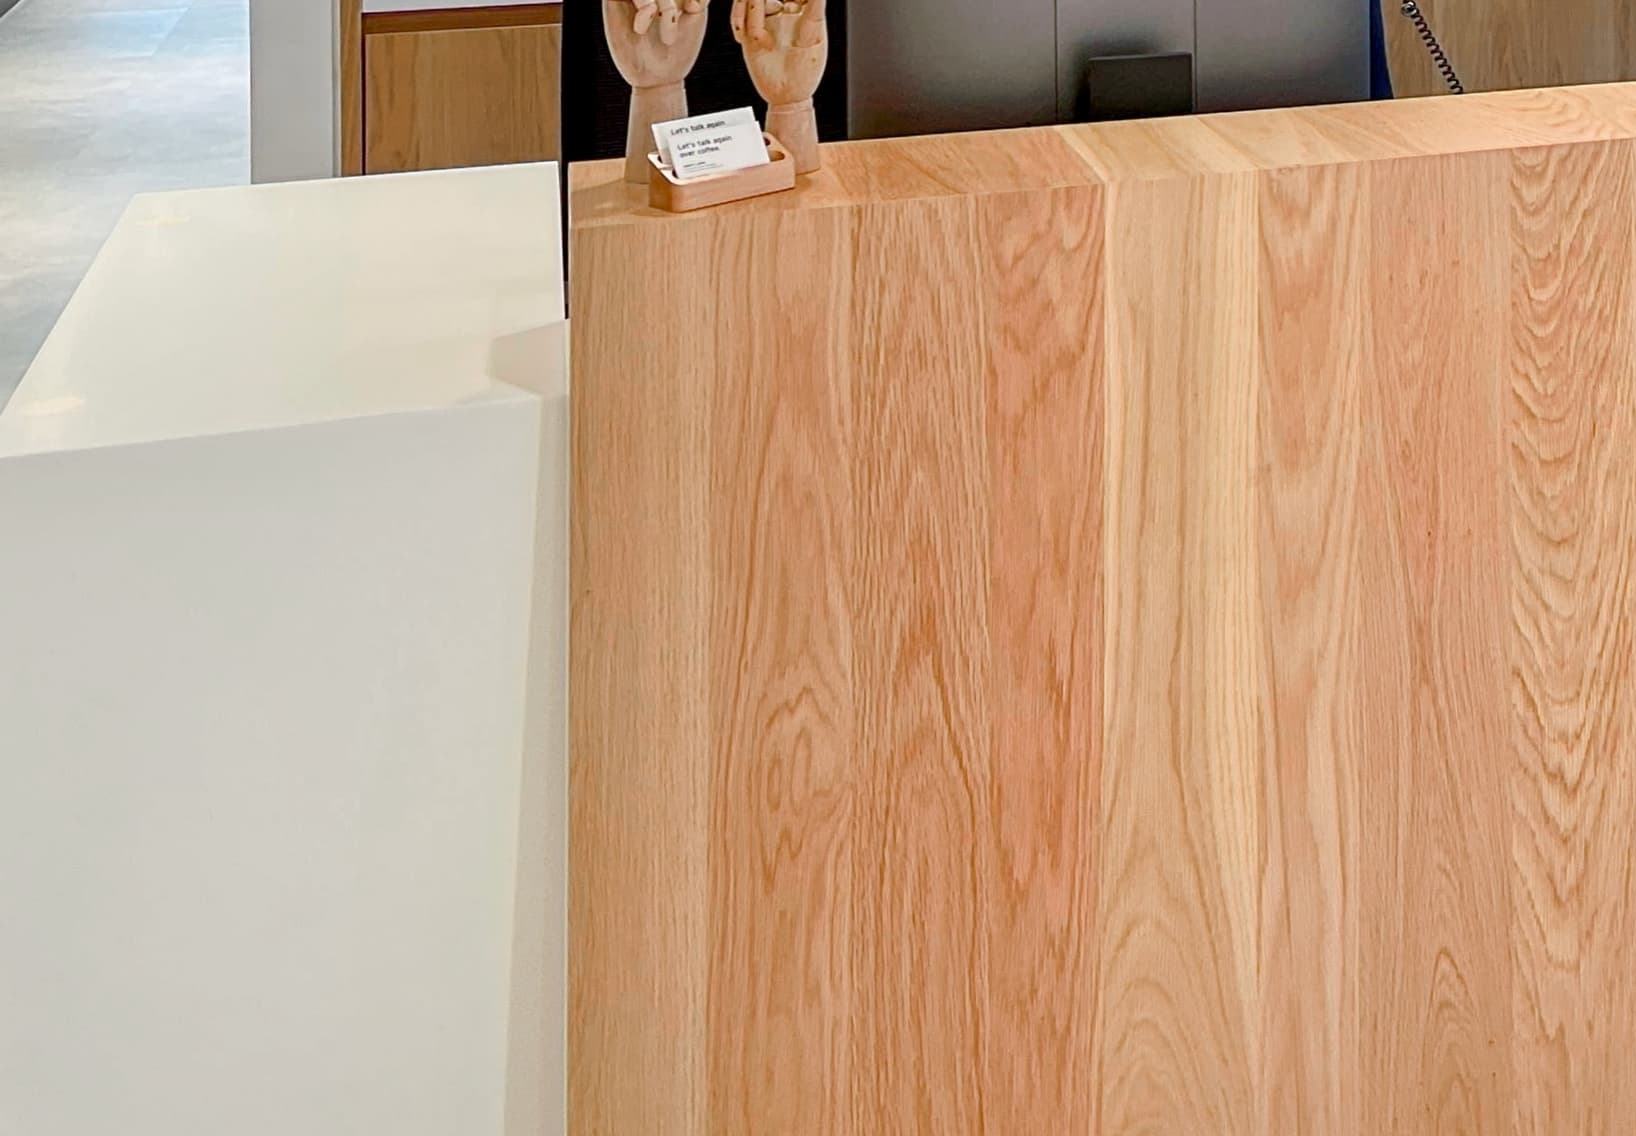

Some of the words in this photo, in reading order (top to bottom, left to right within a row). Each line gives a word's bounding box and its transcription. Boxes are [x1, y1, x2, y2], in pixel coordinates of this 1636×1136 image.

[671, 127, 689, 135] Let's
[677, 142, 696, 151] Let's
[679, 150, 695, 158] over
